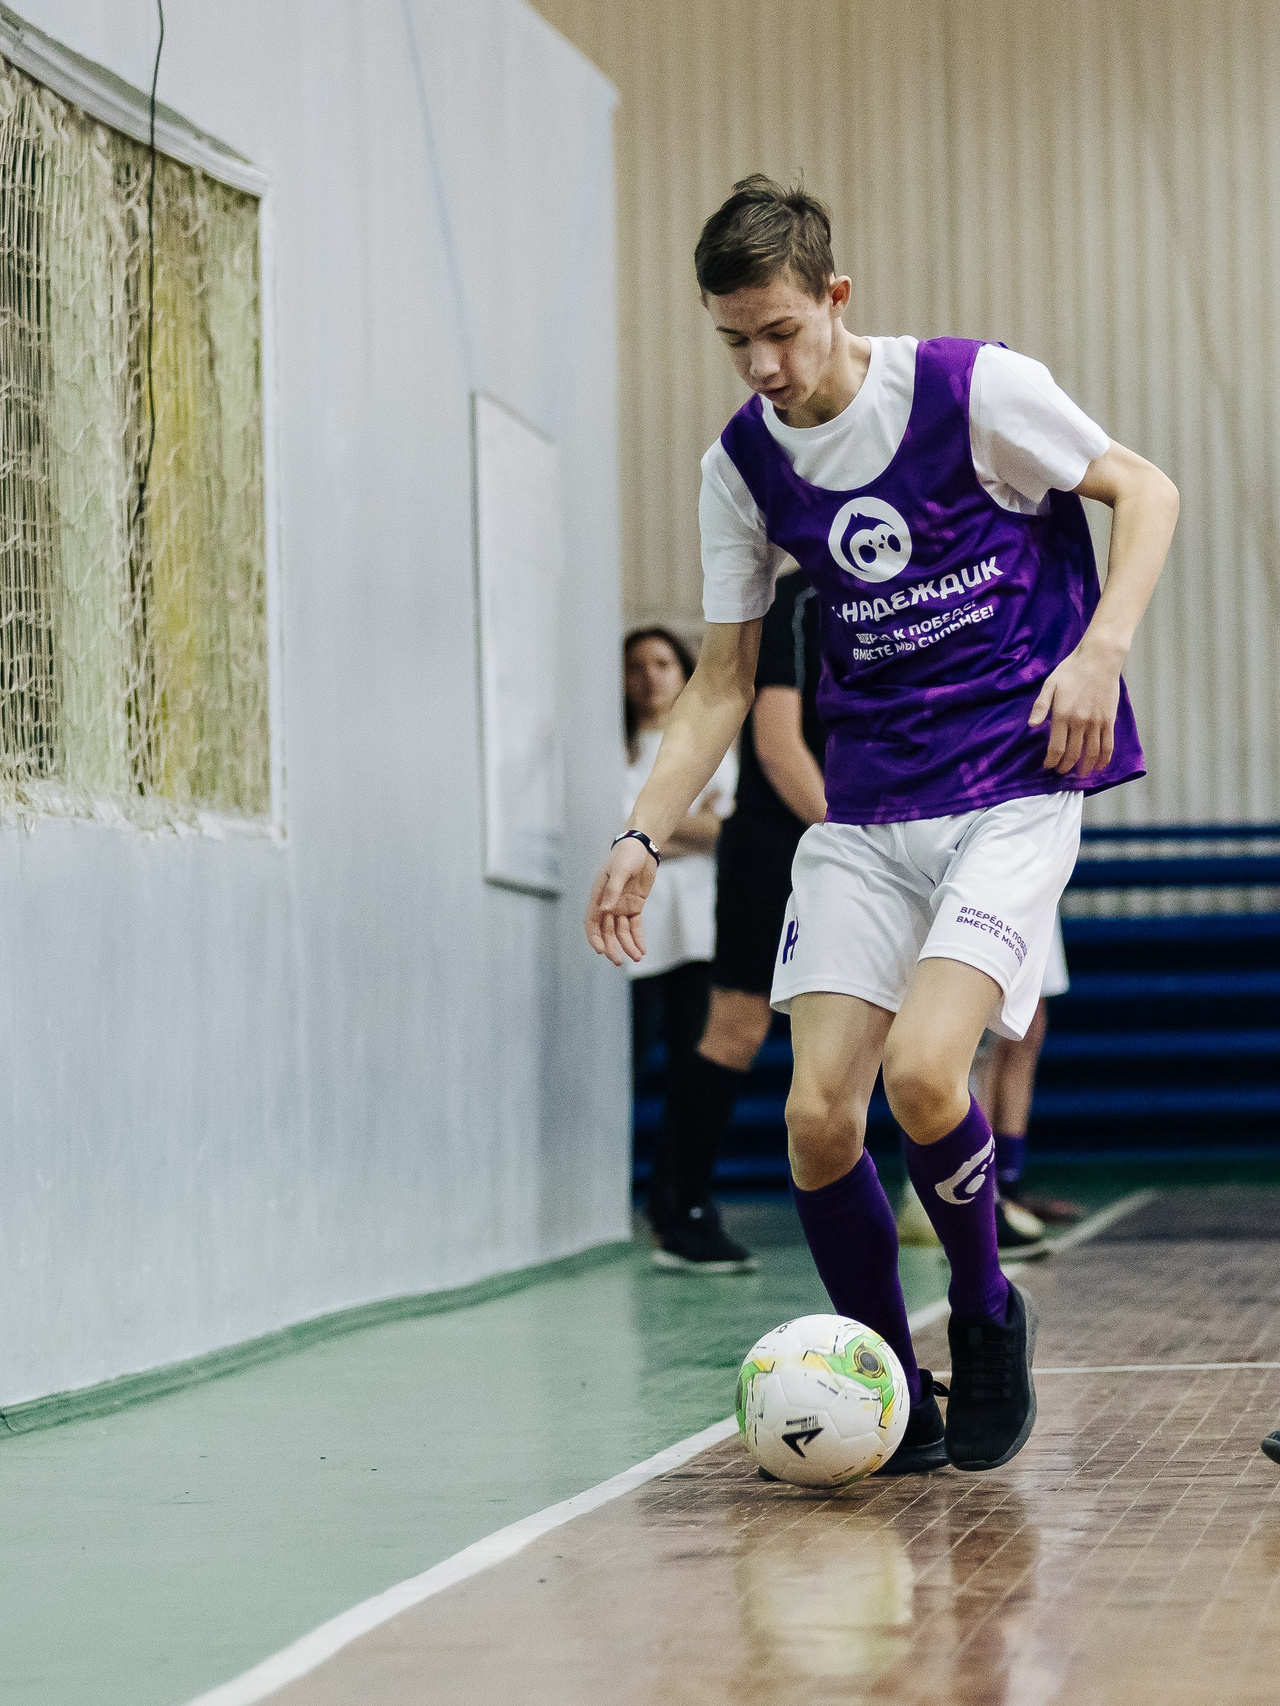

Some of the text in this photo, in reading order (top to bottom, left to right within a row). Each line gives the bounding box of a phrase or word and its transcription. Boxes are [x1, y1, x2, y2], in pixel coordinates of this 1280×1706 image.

[893, 628, 906, 641] К
[853, 644, 894, 661] ВМЕСТЕ
[896, 641, 916, 654] МЫ
[956, 915, 1016, 952] ВМЕСТЕ МЫ
[960, 906, 1004, 930] ВПЕРЁД
[1005, 925, 1013, 936] К
